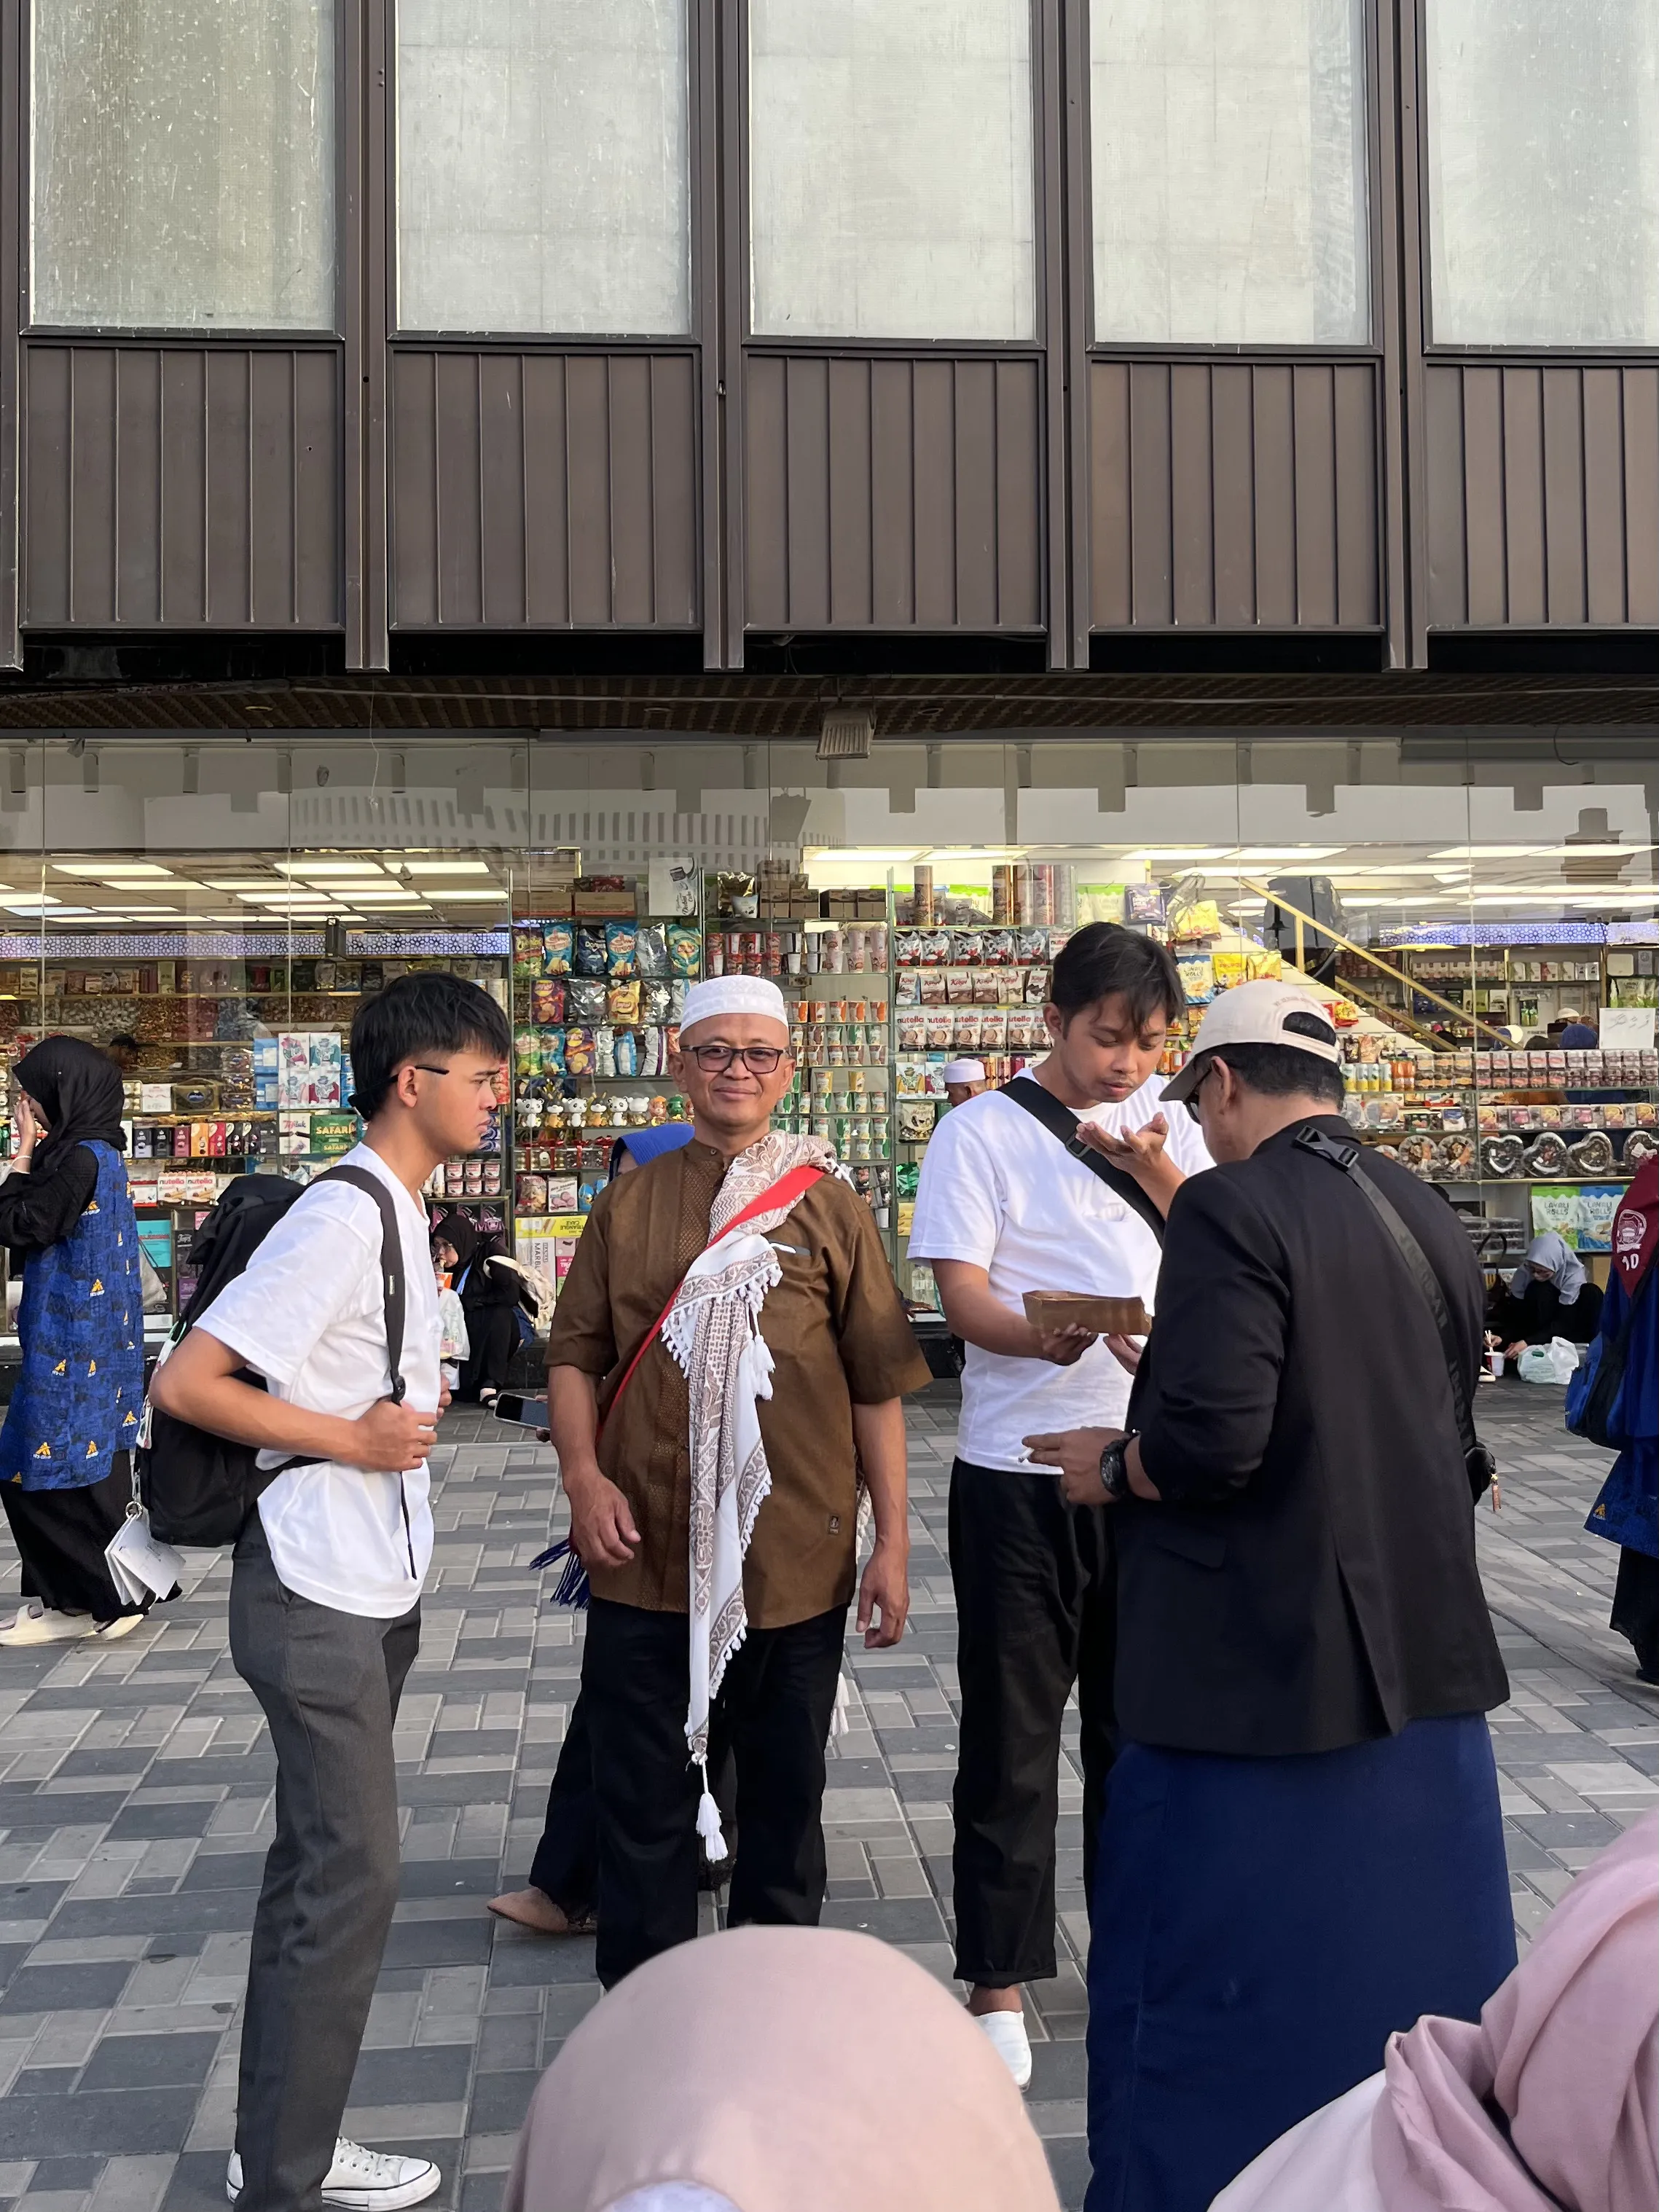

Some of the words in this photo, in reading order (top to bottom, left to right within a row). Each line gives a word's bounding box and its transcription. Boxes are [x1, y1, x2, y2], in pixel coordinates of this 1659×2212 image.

[897, 1016, 925, 1024] nutella
[927, 1016, 952, 1024] nutella
[315, 1126, 354, 1134] SAFARI
[159, 1177, 184, 1185] nutella
[187, 1177, 213, 1185] nutella
[1622, 1253, 1639, 1271] 10
